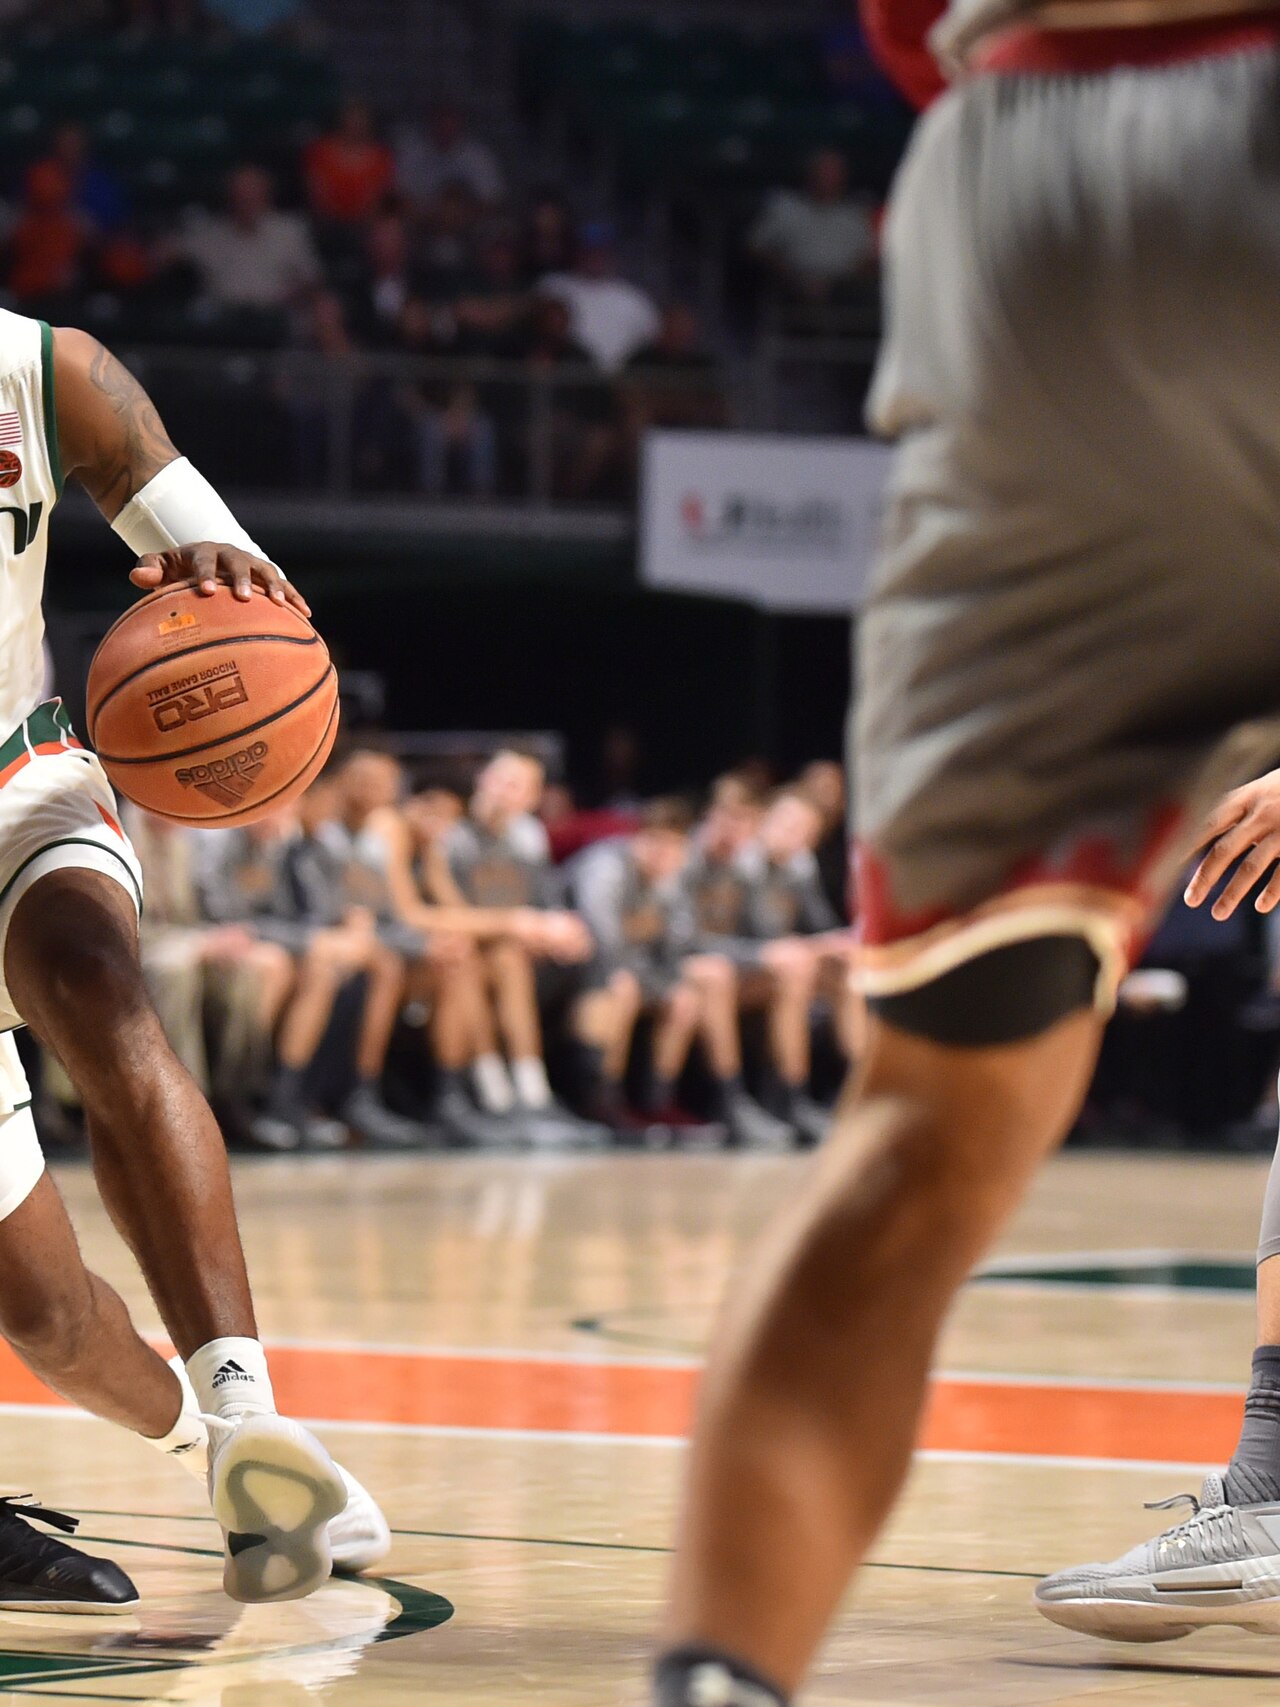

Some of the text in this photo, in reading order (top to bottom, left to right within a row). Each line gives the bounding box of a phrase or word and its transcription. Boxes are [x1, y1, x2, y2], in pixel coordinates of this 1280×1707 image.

[146, 660, 237, 701] INDOOR GAME BALL
[153, 676, 249, 732] PRO
[175, 741, 268, 788] adidas
[211, 1371, 255, 1389] adidas
